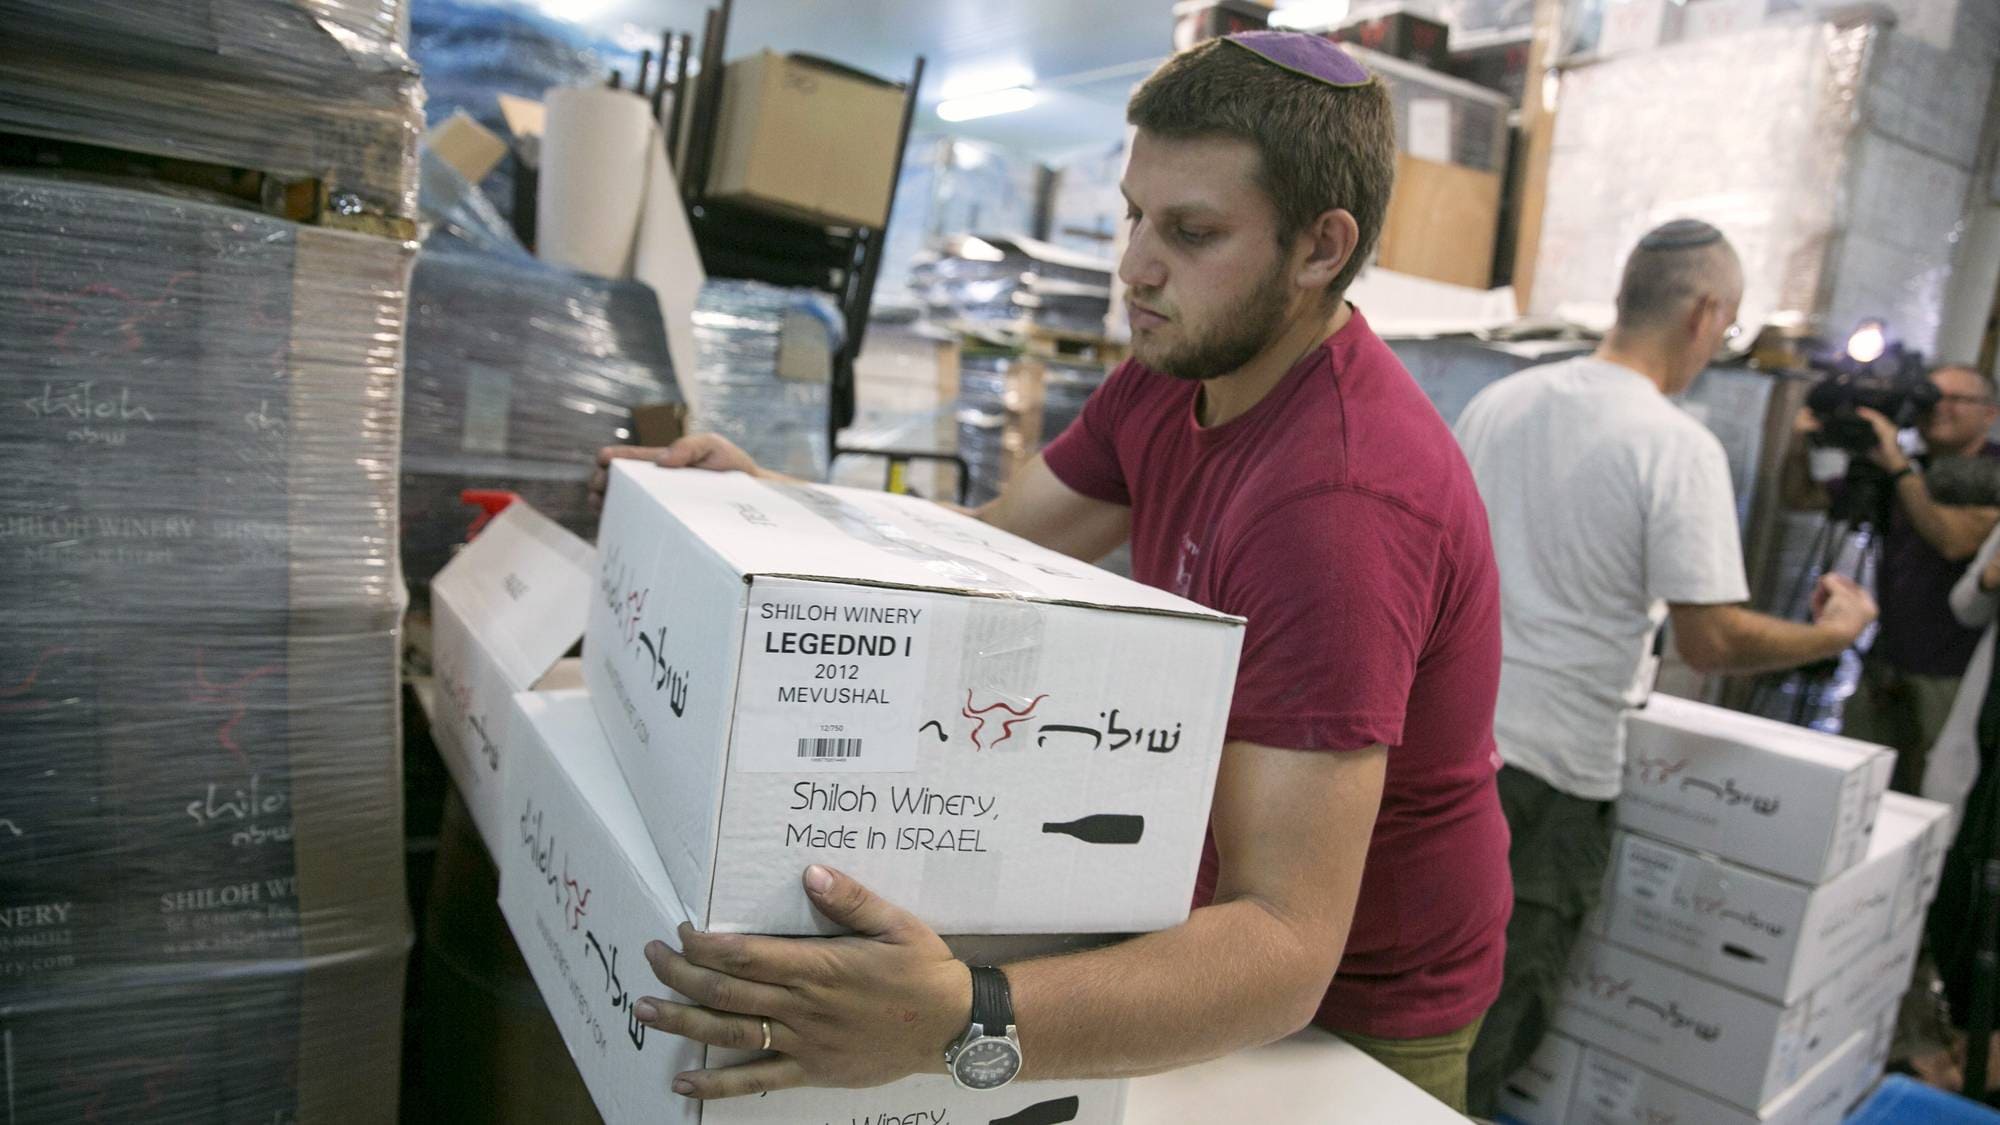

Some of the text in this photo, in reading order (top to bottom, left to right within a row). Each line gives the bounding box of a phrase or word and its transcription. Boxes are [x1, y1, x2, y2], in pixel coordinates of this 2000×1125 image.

[760, 602, 922, 625] SHILOH WINERY
[765, 631, 913, 657] LEGEDND I
[814, 663, 860, 680] 2012
[777, 686, 891, 704] MEVUSHAL
[790, 781, 999, 821] Shiloh Winery,
[785, 823, 988, 852] Made In ISRAEL
[161, 882, 261, 913] SHILOH
